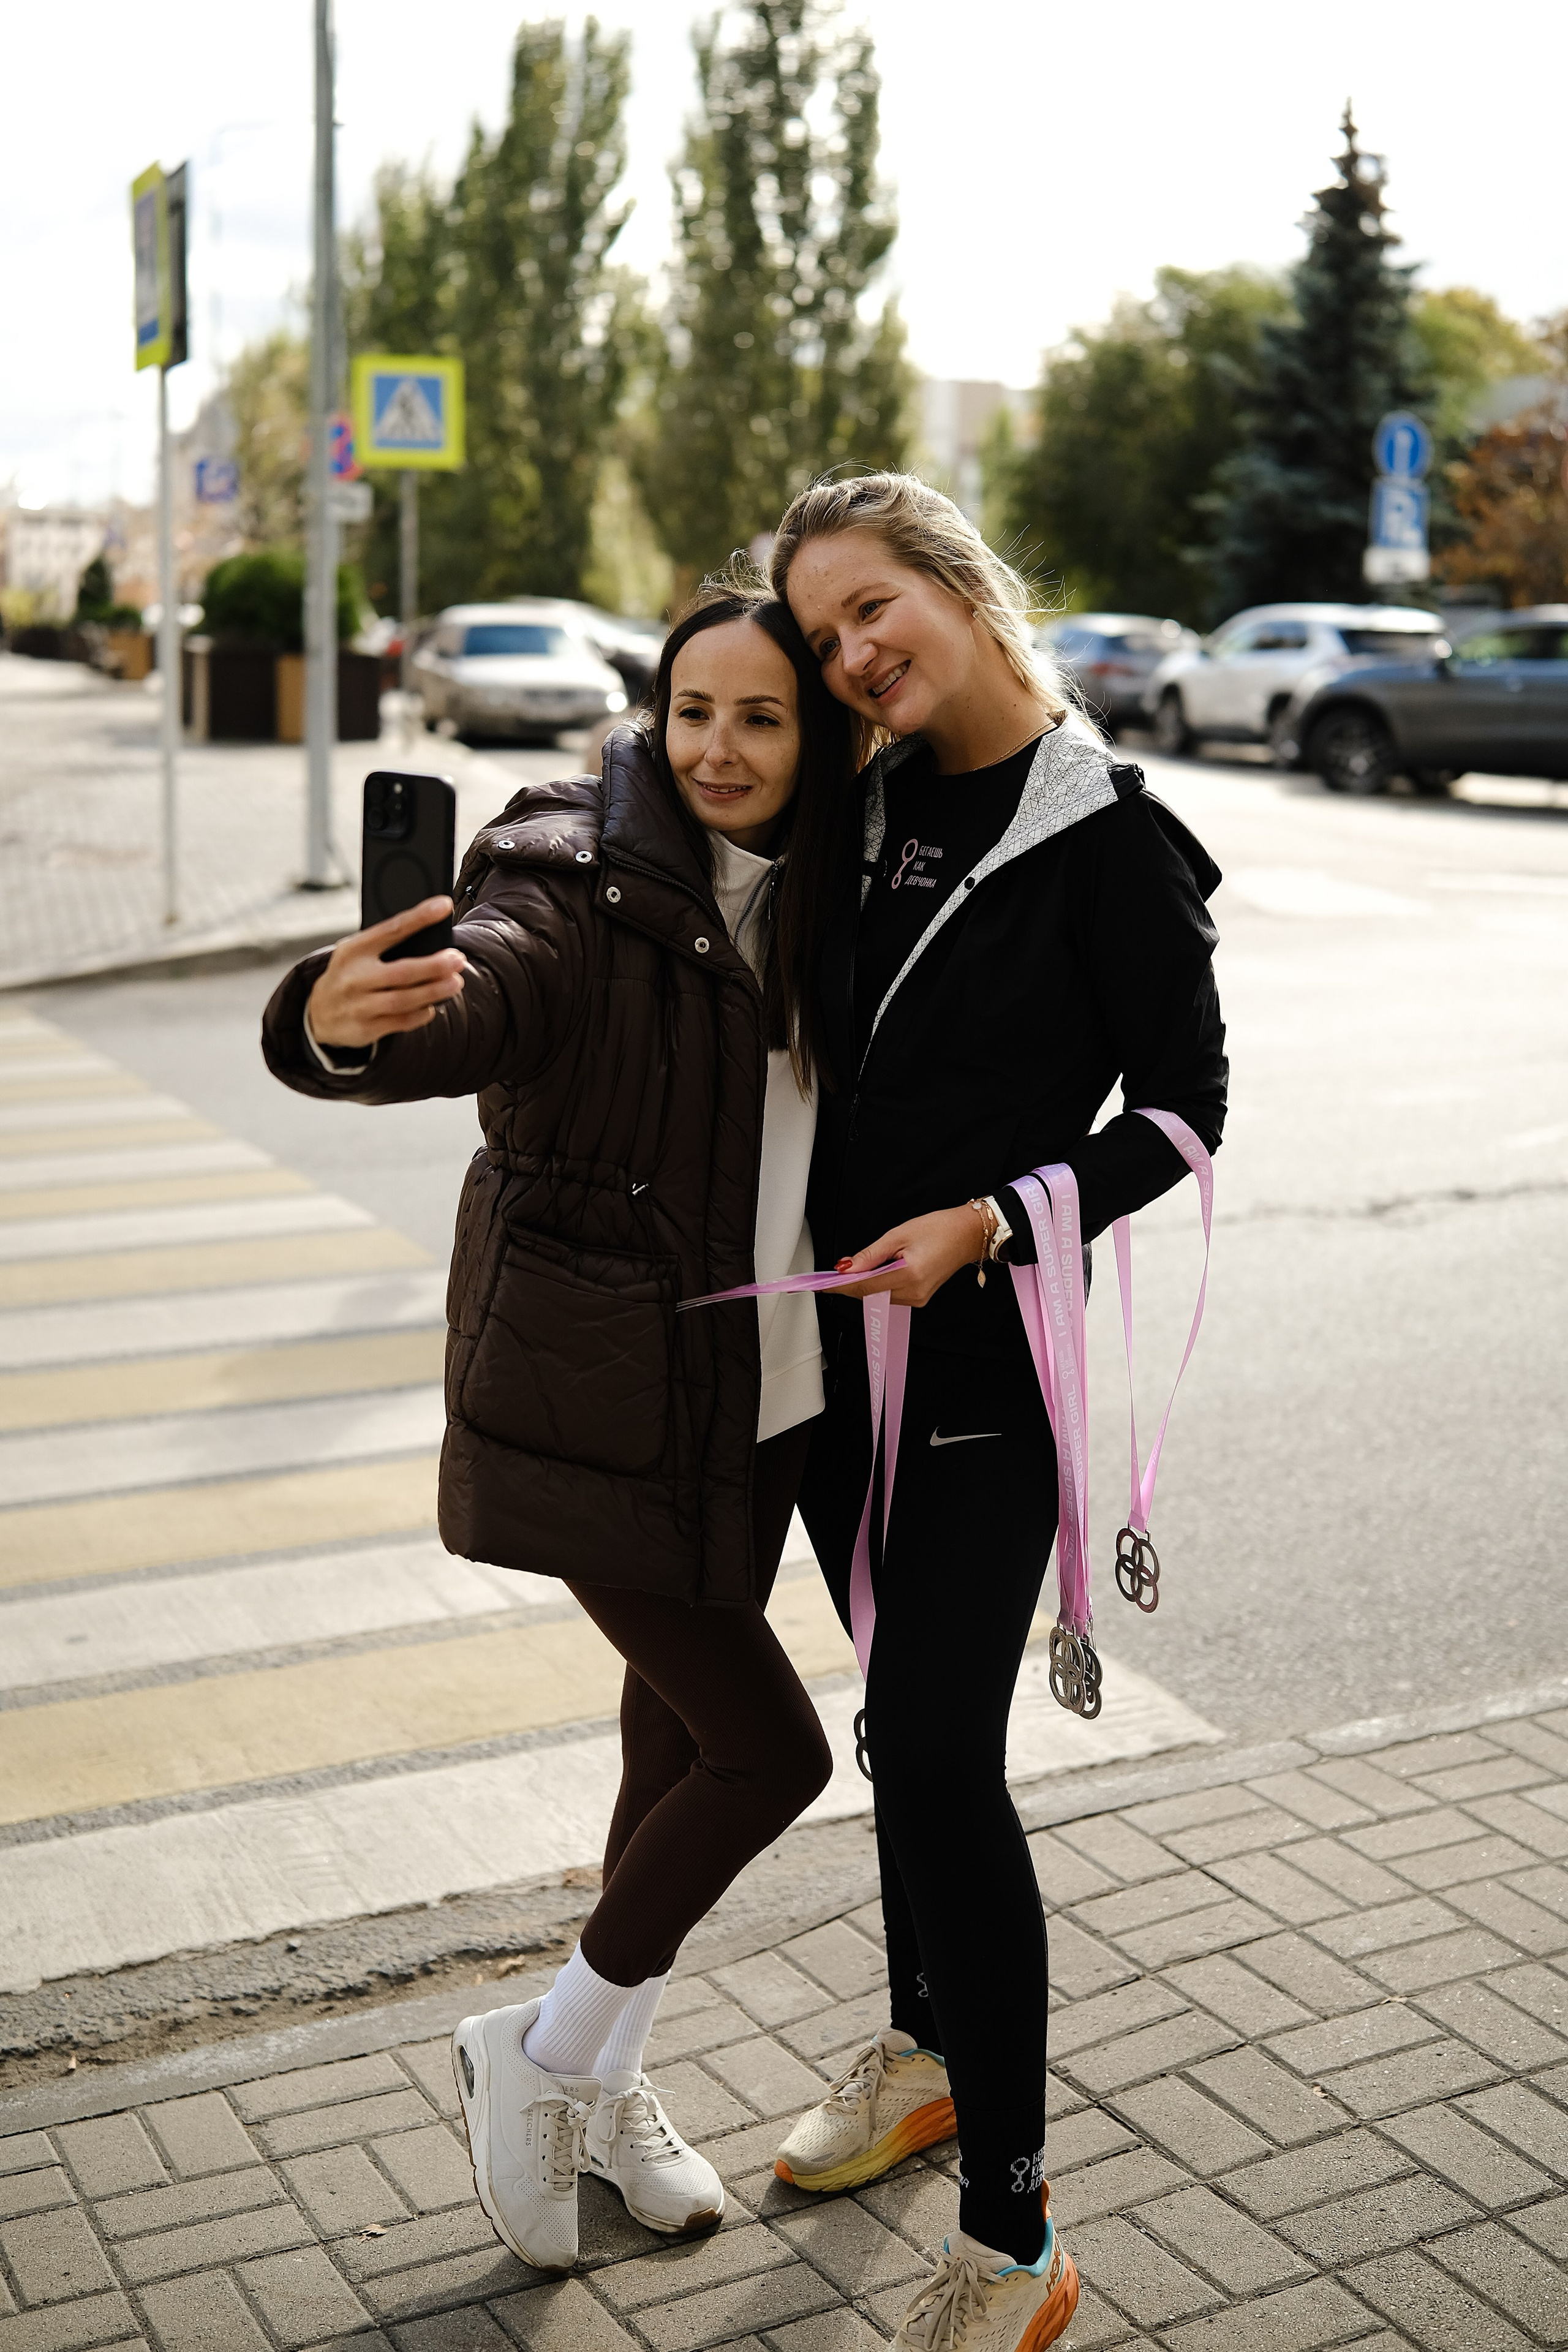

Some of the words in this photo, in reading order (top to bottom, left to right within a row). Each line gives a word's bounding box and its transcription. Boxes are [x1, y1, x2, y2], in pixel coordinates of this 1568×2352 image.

[919, 845, 943, 858] БЕГАЕШЬ
[913, 861, 925, 872] КАК
[904, 875, 937, 888] ДЕВЧОНКА
[1178, 1137, 1189, 1145] I
[1183, 1145, 1204, 1163] AM
[1198, 1165, 1209, 1175] A
[1023, 1180, 1044, 1215] GIRL
[1061, 1204, 1072, 1232] AM
[1038, 1218, 1057, 1278] SUPER
[1061, 1237, 1072, 1249] A
[1050, 1282, 1060, 1294] A
[1052, 1299, 1065, 1327] AM
[870, 1316, 881, 1343] AM
[872, 1348, 880, 1358] A
[872, 1360, 881, 1413] SUPER
[1067, 1384, 1080, 1425] GIRL
[1063, 1448, 1071, 1461] A
[1073, 1427, 1084, 1485] SUPER
[1063, 1465, 1073, 1521] SUPER
